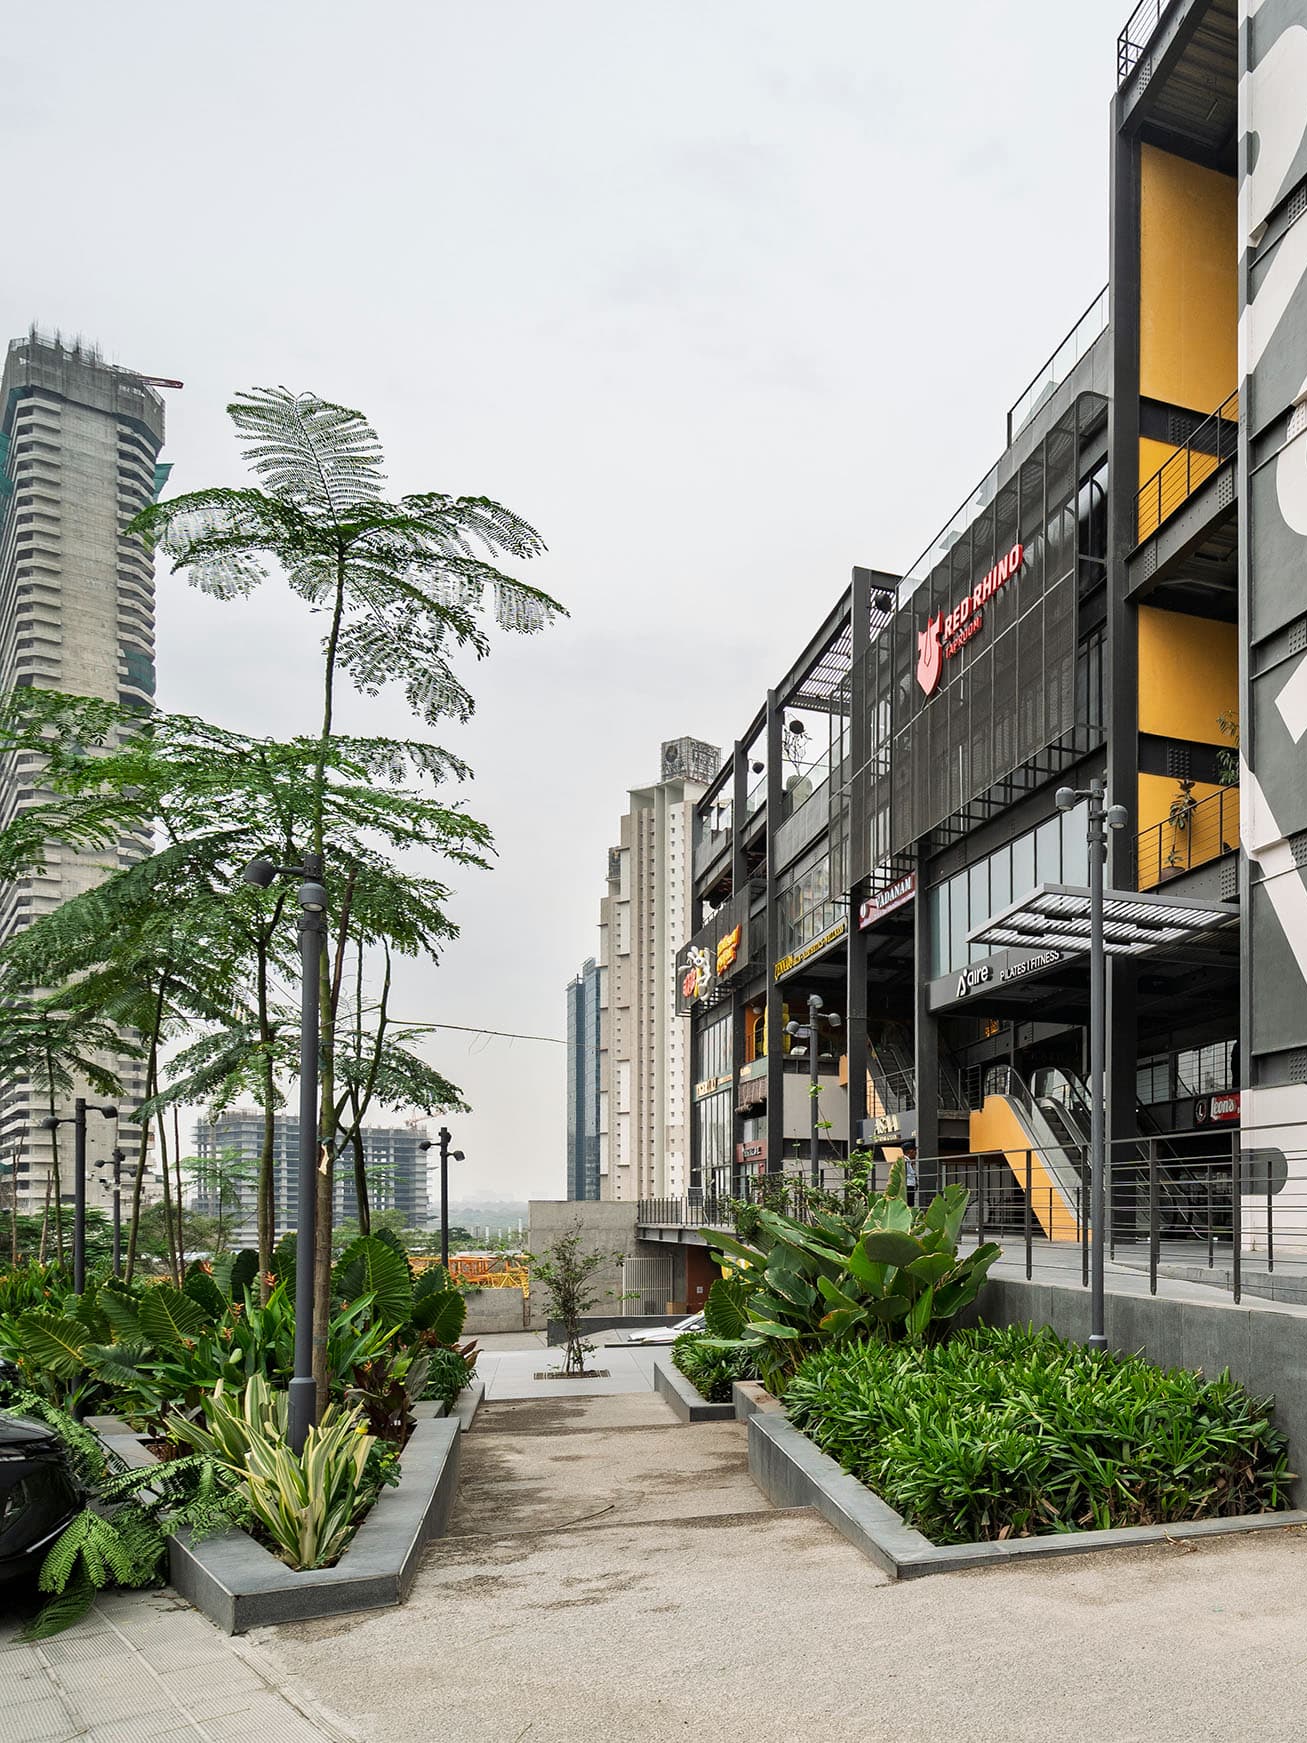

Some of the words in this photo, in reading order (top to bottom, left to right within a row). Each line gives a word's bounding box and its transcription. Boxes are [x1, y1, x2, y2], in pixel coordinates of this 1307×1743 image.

[944, 596, 972, 641] RED
[972, 543, 1023, 609] RHINO
[999, 962, 1026, 981] PILATES
[1030, 950, 1060, 970] FITNESS
